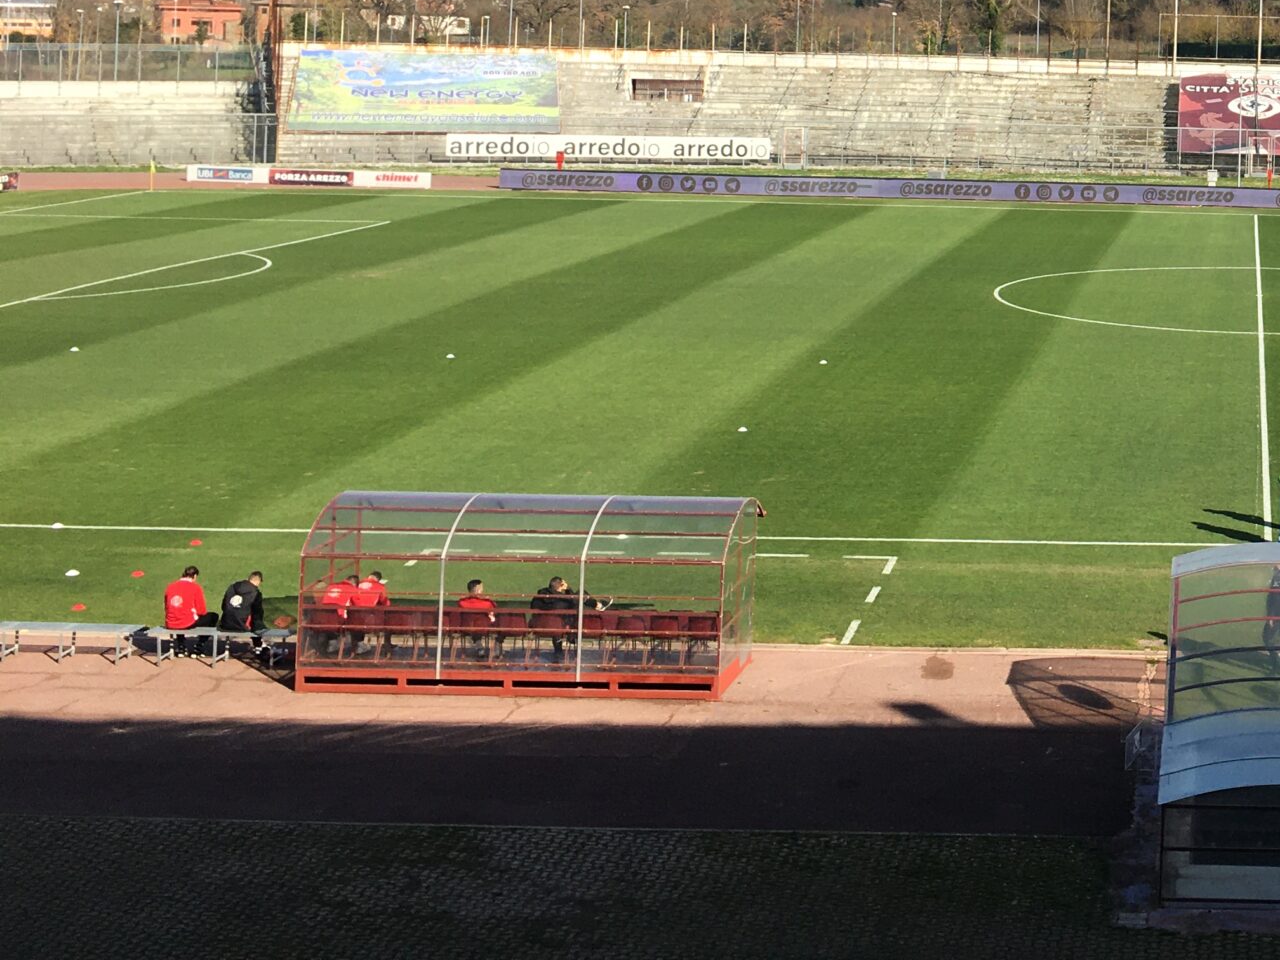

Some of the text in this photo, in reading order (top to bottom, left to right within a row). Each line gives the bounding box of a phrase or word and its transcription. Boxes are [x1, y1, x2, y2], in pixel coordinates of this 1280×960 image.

[197, 169, 253, 181] UBI Banca
[274, 172, 348, 183] FORZA AREZZO
[375, 173, 419, 183] chimet
[521, 172, 615, 188] @ssarezzo
[764, 179, 858, 195] @ssarezzo
[900, 181, 992, 196] @ssarezzo
[1142, 187, 1235, 203] @ssarezzo
